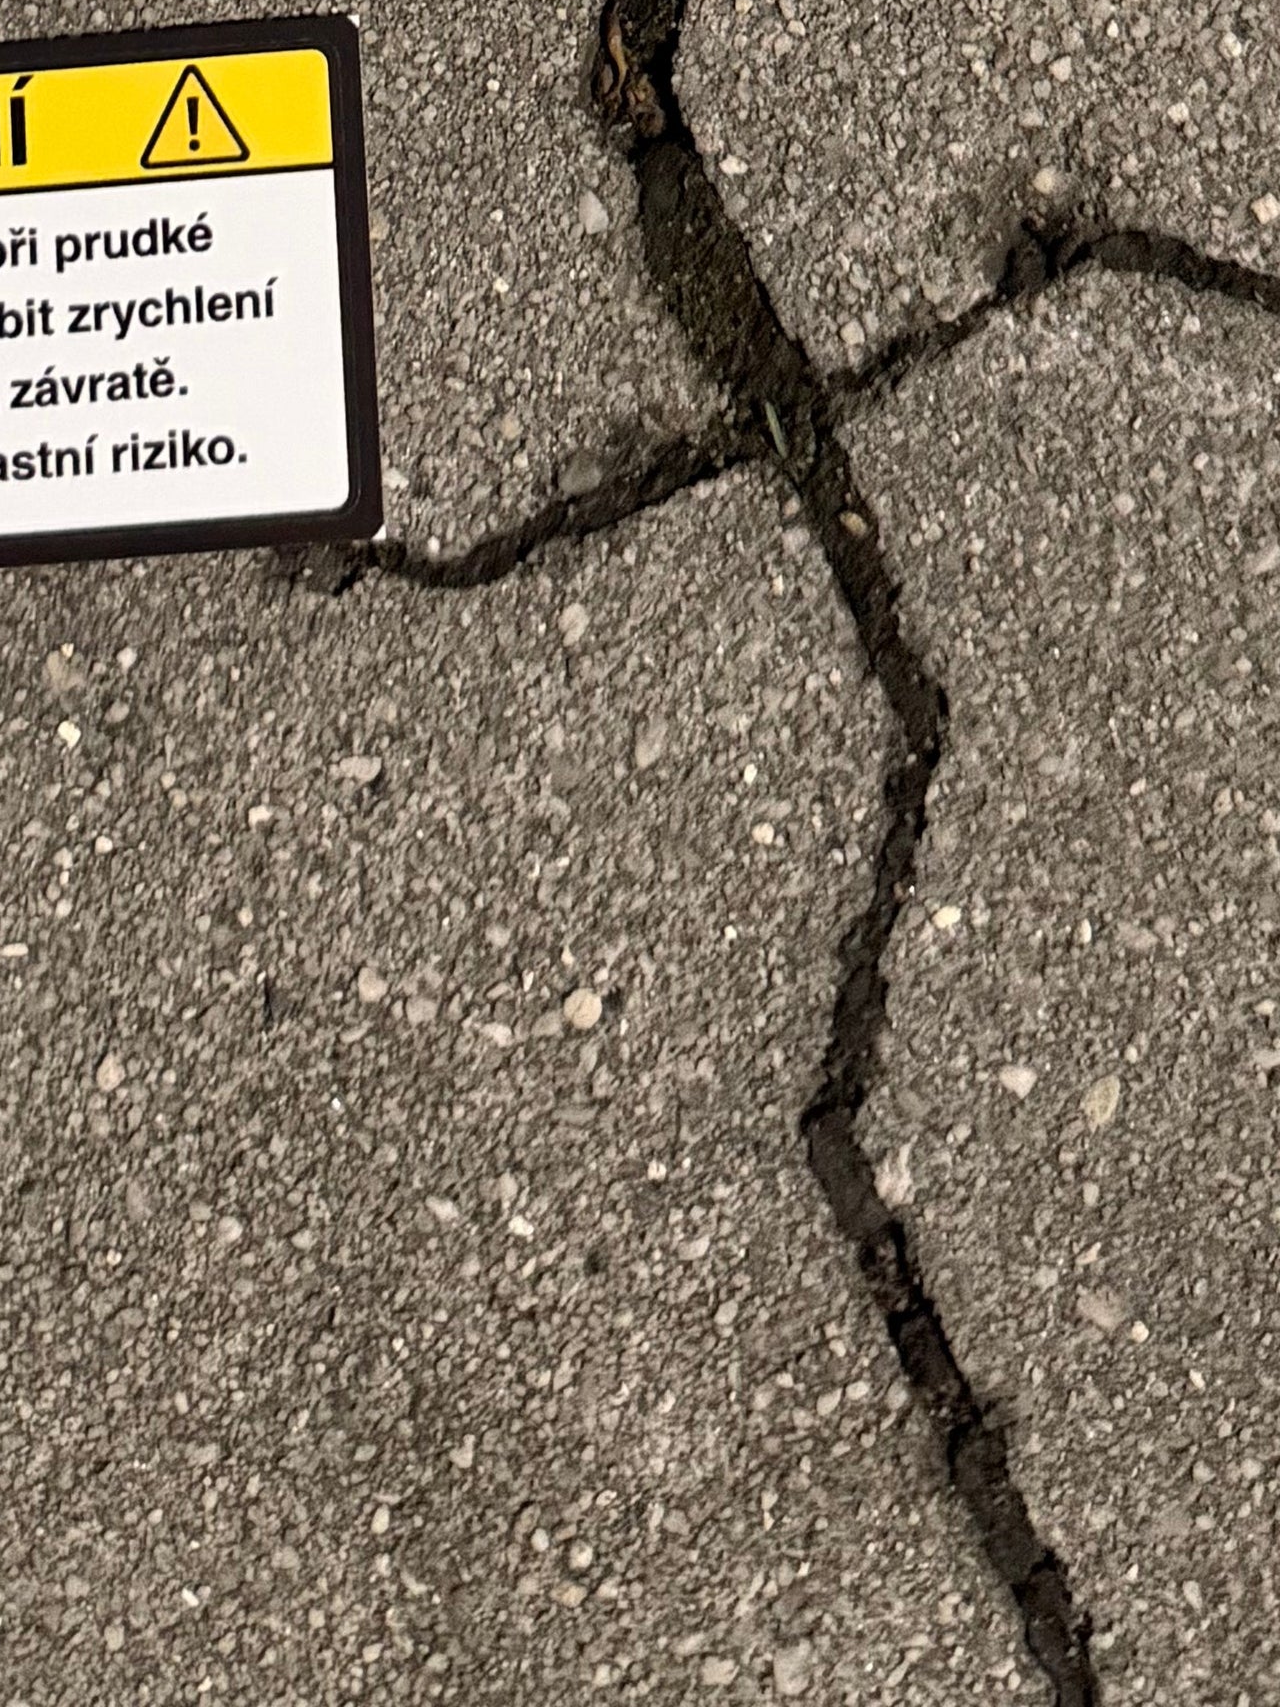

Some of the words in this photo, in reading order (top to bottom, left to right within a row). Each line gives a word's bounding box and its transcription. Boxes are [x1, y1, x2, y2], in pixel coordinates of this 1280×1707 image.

[54, 211, 214, 274] prudké
[66, 276, 278, 342] zrychlení
[9, 356, 189, 410] závratě.
[111, 429, 248, 474] riziko.
